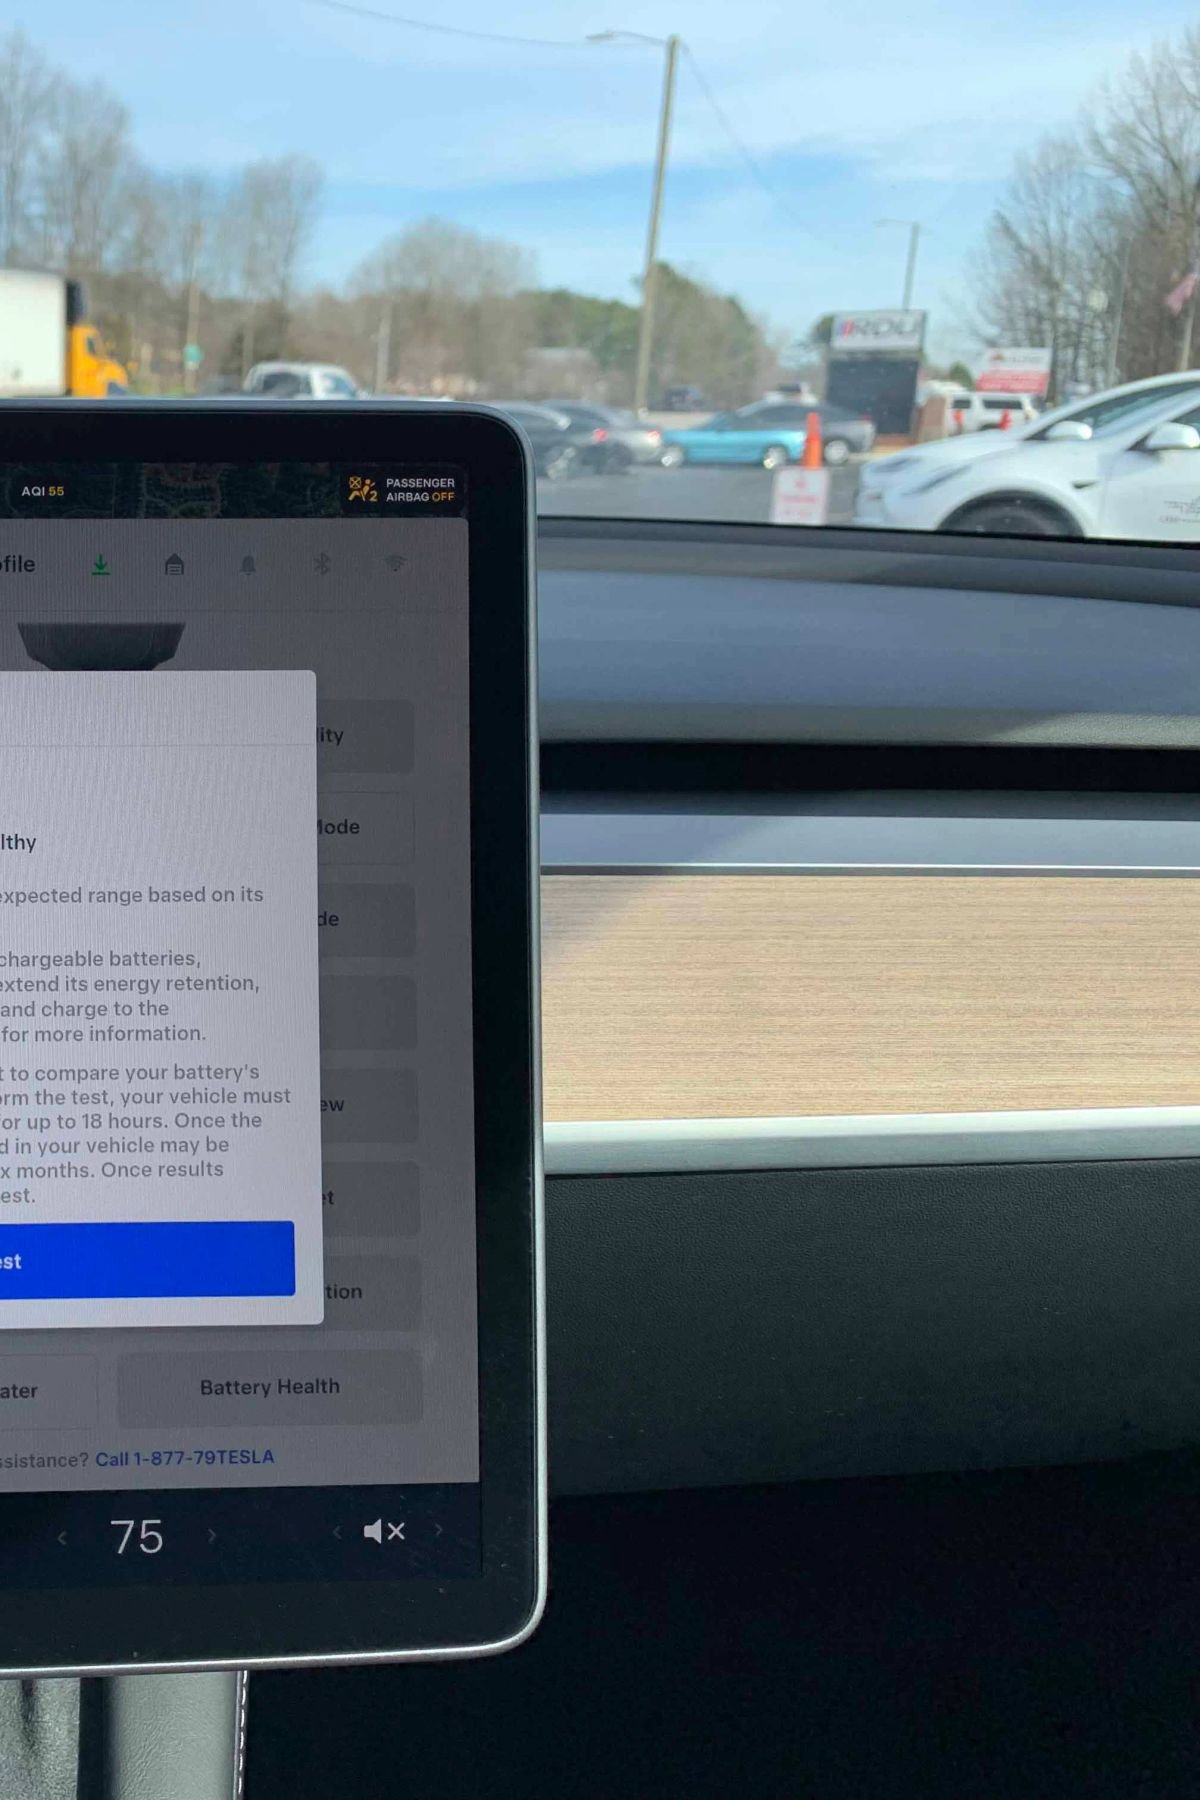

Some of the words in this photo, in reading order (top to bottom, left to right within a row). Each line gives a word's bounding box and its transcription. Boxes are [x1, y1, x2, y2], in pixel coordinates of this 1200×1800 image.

[20, 485, 45, 496] AQI
[48, 485, 64, 496] 55
[385, 477, 455, 488] PASSENGER
[385, 491, 429, 502] AIRBAG
[431, 491, 454, 501] OFF
[88, 889, 142, 907] range
[148, 885, 205, 903] based
[210, 889, 235, 902] on
[240, 885, 263, 902] its
[109, 948, 200, 969] batteries,
[65, 974, 88, 992] its
[93, 978, 160, 995] energy
[166, 973, 259, 994] retention,
[0, 999, 35, 1017] and
[40, 999, 108, 1020] charge
[113, 1000, 133, 1016] to
[137, 998, 169, 1016] the
[0, 1025, 29, 1042] for
[34, 1029, 83, 1042] more
[89, 1023, 206, 1042] information.
[9, 1065, 29, 1082] to
[34, 1067, 119, 1084] compare
[124, 1067, 168, 1084] your
[173, 1062, 259, 1083] battery's
[200, 1378, 271, 1398] Battery
[277, 1376, 340, 1394] Health
[95, 1450, 129, 1467] Call
[133, 1448, 274, 1466] 1-877-79TESLA
[110, 1519, 163, 1554] 75
